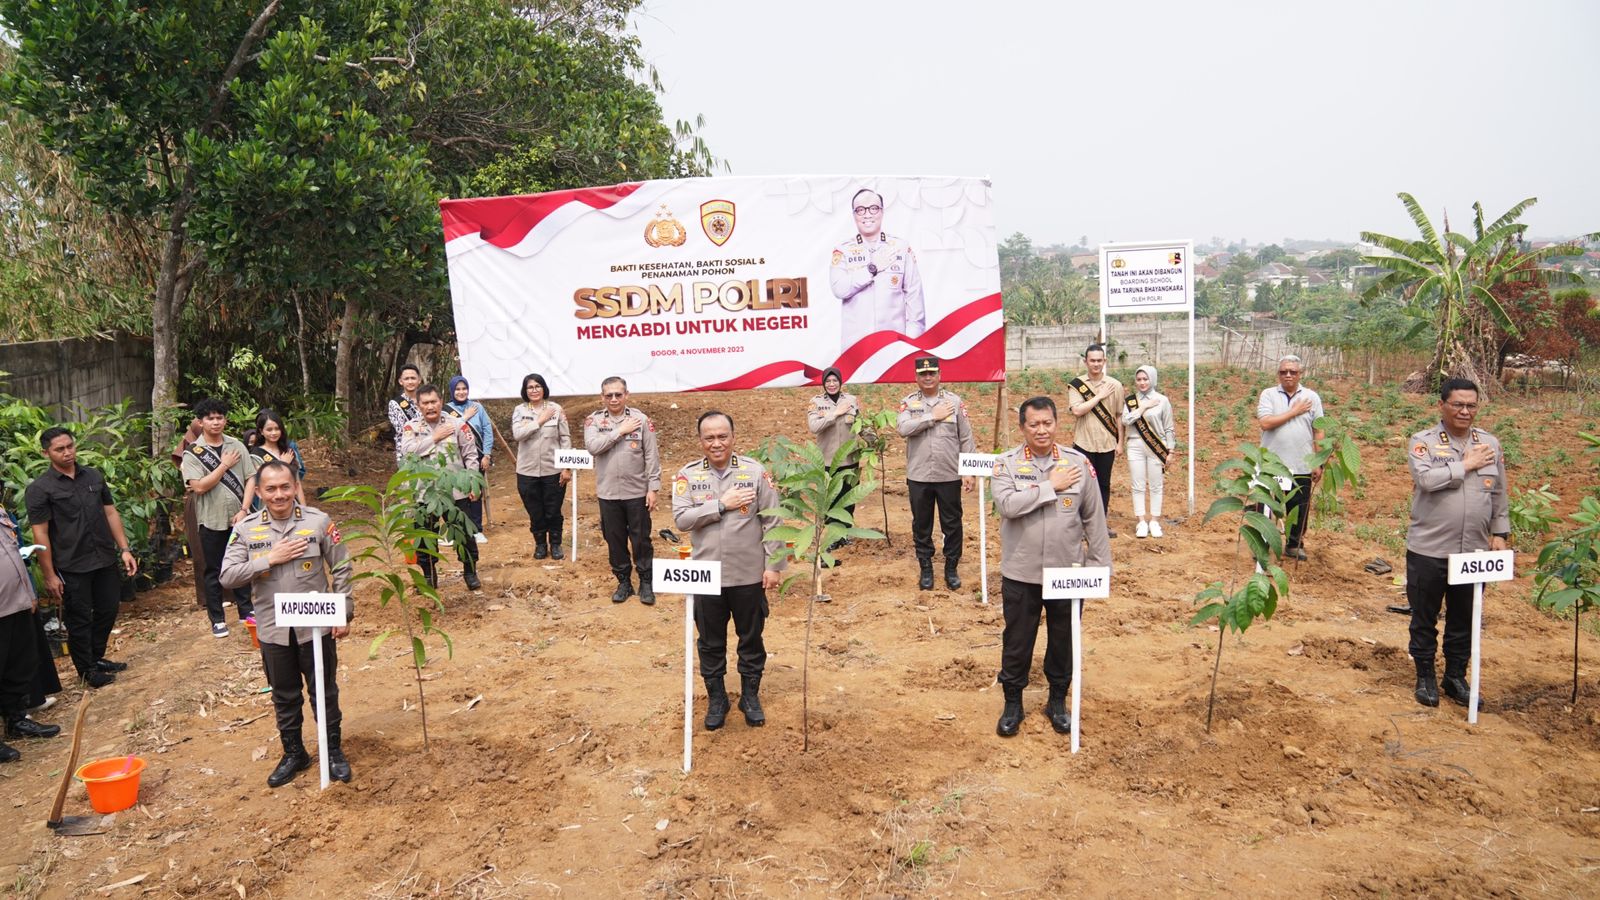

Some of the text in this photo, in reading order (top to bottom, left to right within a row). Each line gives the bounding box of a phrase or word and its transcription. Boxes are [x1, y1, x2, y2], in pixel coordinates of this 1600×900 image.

[610, 264, 636, 272] BAKTI
[639, 261, 694, 271] KESEHATAN,
[696, 259, 722, 267] BAKTI
[725, 258, 756, 266] SOSIAL
[641, 267, 735, 279] PENANAMAN POHON
[1144, 285, 1183, 293] BHAYANGKARA
[573, 277, 809, 320] SSDM POLRI
[576, 315, 808, 340] MENGABDI UNTUK NEGERI
[651, 349, 678, 357] BOGOR,
[686, 347, 726, 355] NOVEMBER
[559, 456, 590, 465] KAPUSKU
[962, 459, 994, 468] KADIVKU
[1460, 559, 1504, 574] ASLOG
[663, 568, 711, 583] ASSDM
[1051, 577, 1103, 589] KALEMDIKLAT
[281, 601, 336, 615] KAPUSDOKES
